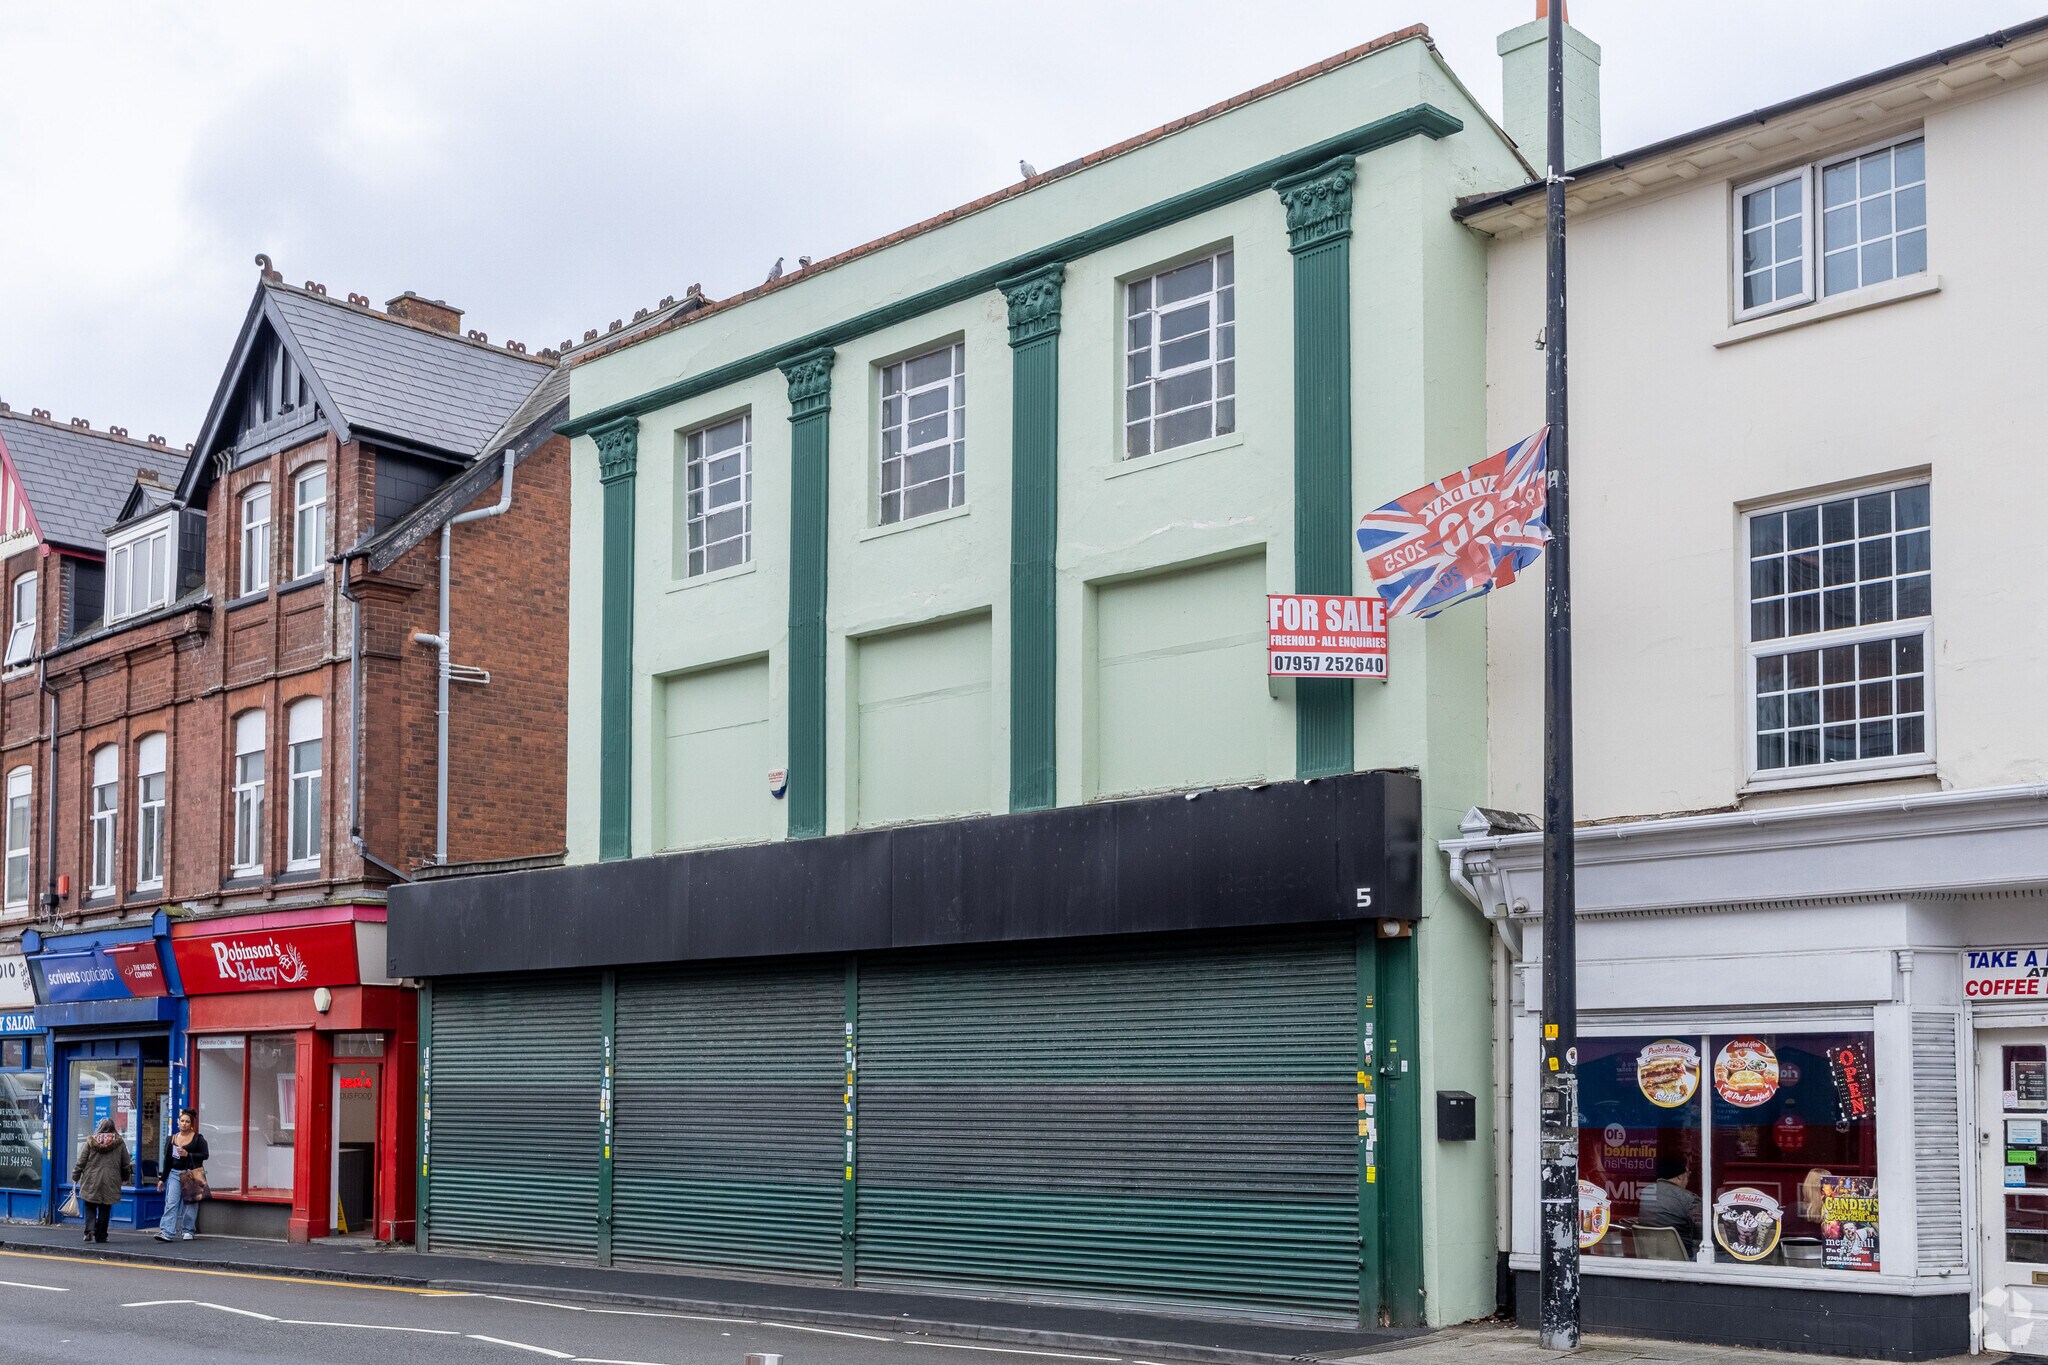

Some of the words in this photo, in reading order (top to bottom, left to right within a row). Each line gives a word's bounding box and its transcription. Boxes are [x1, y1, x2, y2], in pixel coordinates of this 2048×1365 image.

[1270, 597, 1319, 631] FOR
[1325, 598, 1386, 633] SALE
[1271, 634, 1316, 647] FREEHOLD
[1321, 635, 1337, 648] ALL
[1338, 636, 1386, 649] ENQUIRIES
[1274, 656, 1320, 671] 07957
[1325, 656, 1384, 673] 252640
[1357, 888, 1371, 907] 5
[211, 937, 281, 979] Robinson's
[1968, 951, 2018, 968] TAKE
[2024, 951, 2038, 967] A
[48, 969, 81, 985] scrivens
[81, 966, 114, 985] opticians
[134, 970, 153, 979] COMPANY
[235, 960, 278, 985] Bakery
[2027, 968, 2048, 977] AT
[1966, 979, 2039, 996] COFFEE
[6, 1015, 36, 1031] SALON
[1666, 1045, 1690, 1055] Sandwich
[1748, 1040, 1761, 1049] Here
[1839, 1050, 1866, 1115] OPEN
[1723, 1090, 1734, 1099] All
[1733, 1091, 1745, 1101] Day
[1744, 1090, 1770, 1102] Breakfast
[11, 1156, 20, 1167] 544
[1825, 1197, 1879, 1212] GANDEYS
[1731, 1242, 1745, 1253] Sold
[1745, 1245, 1761, 1256] Here
